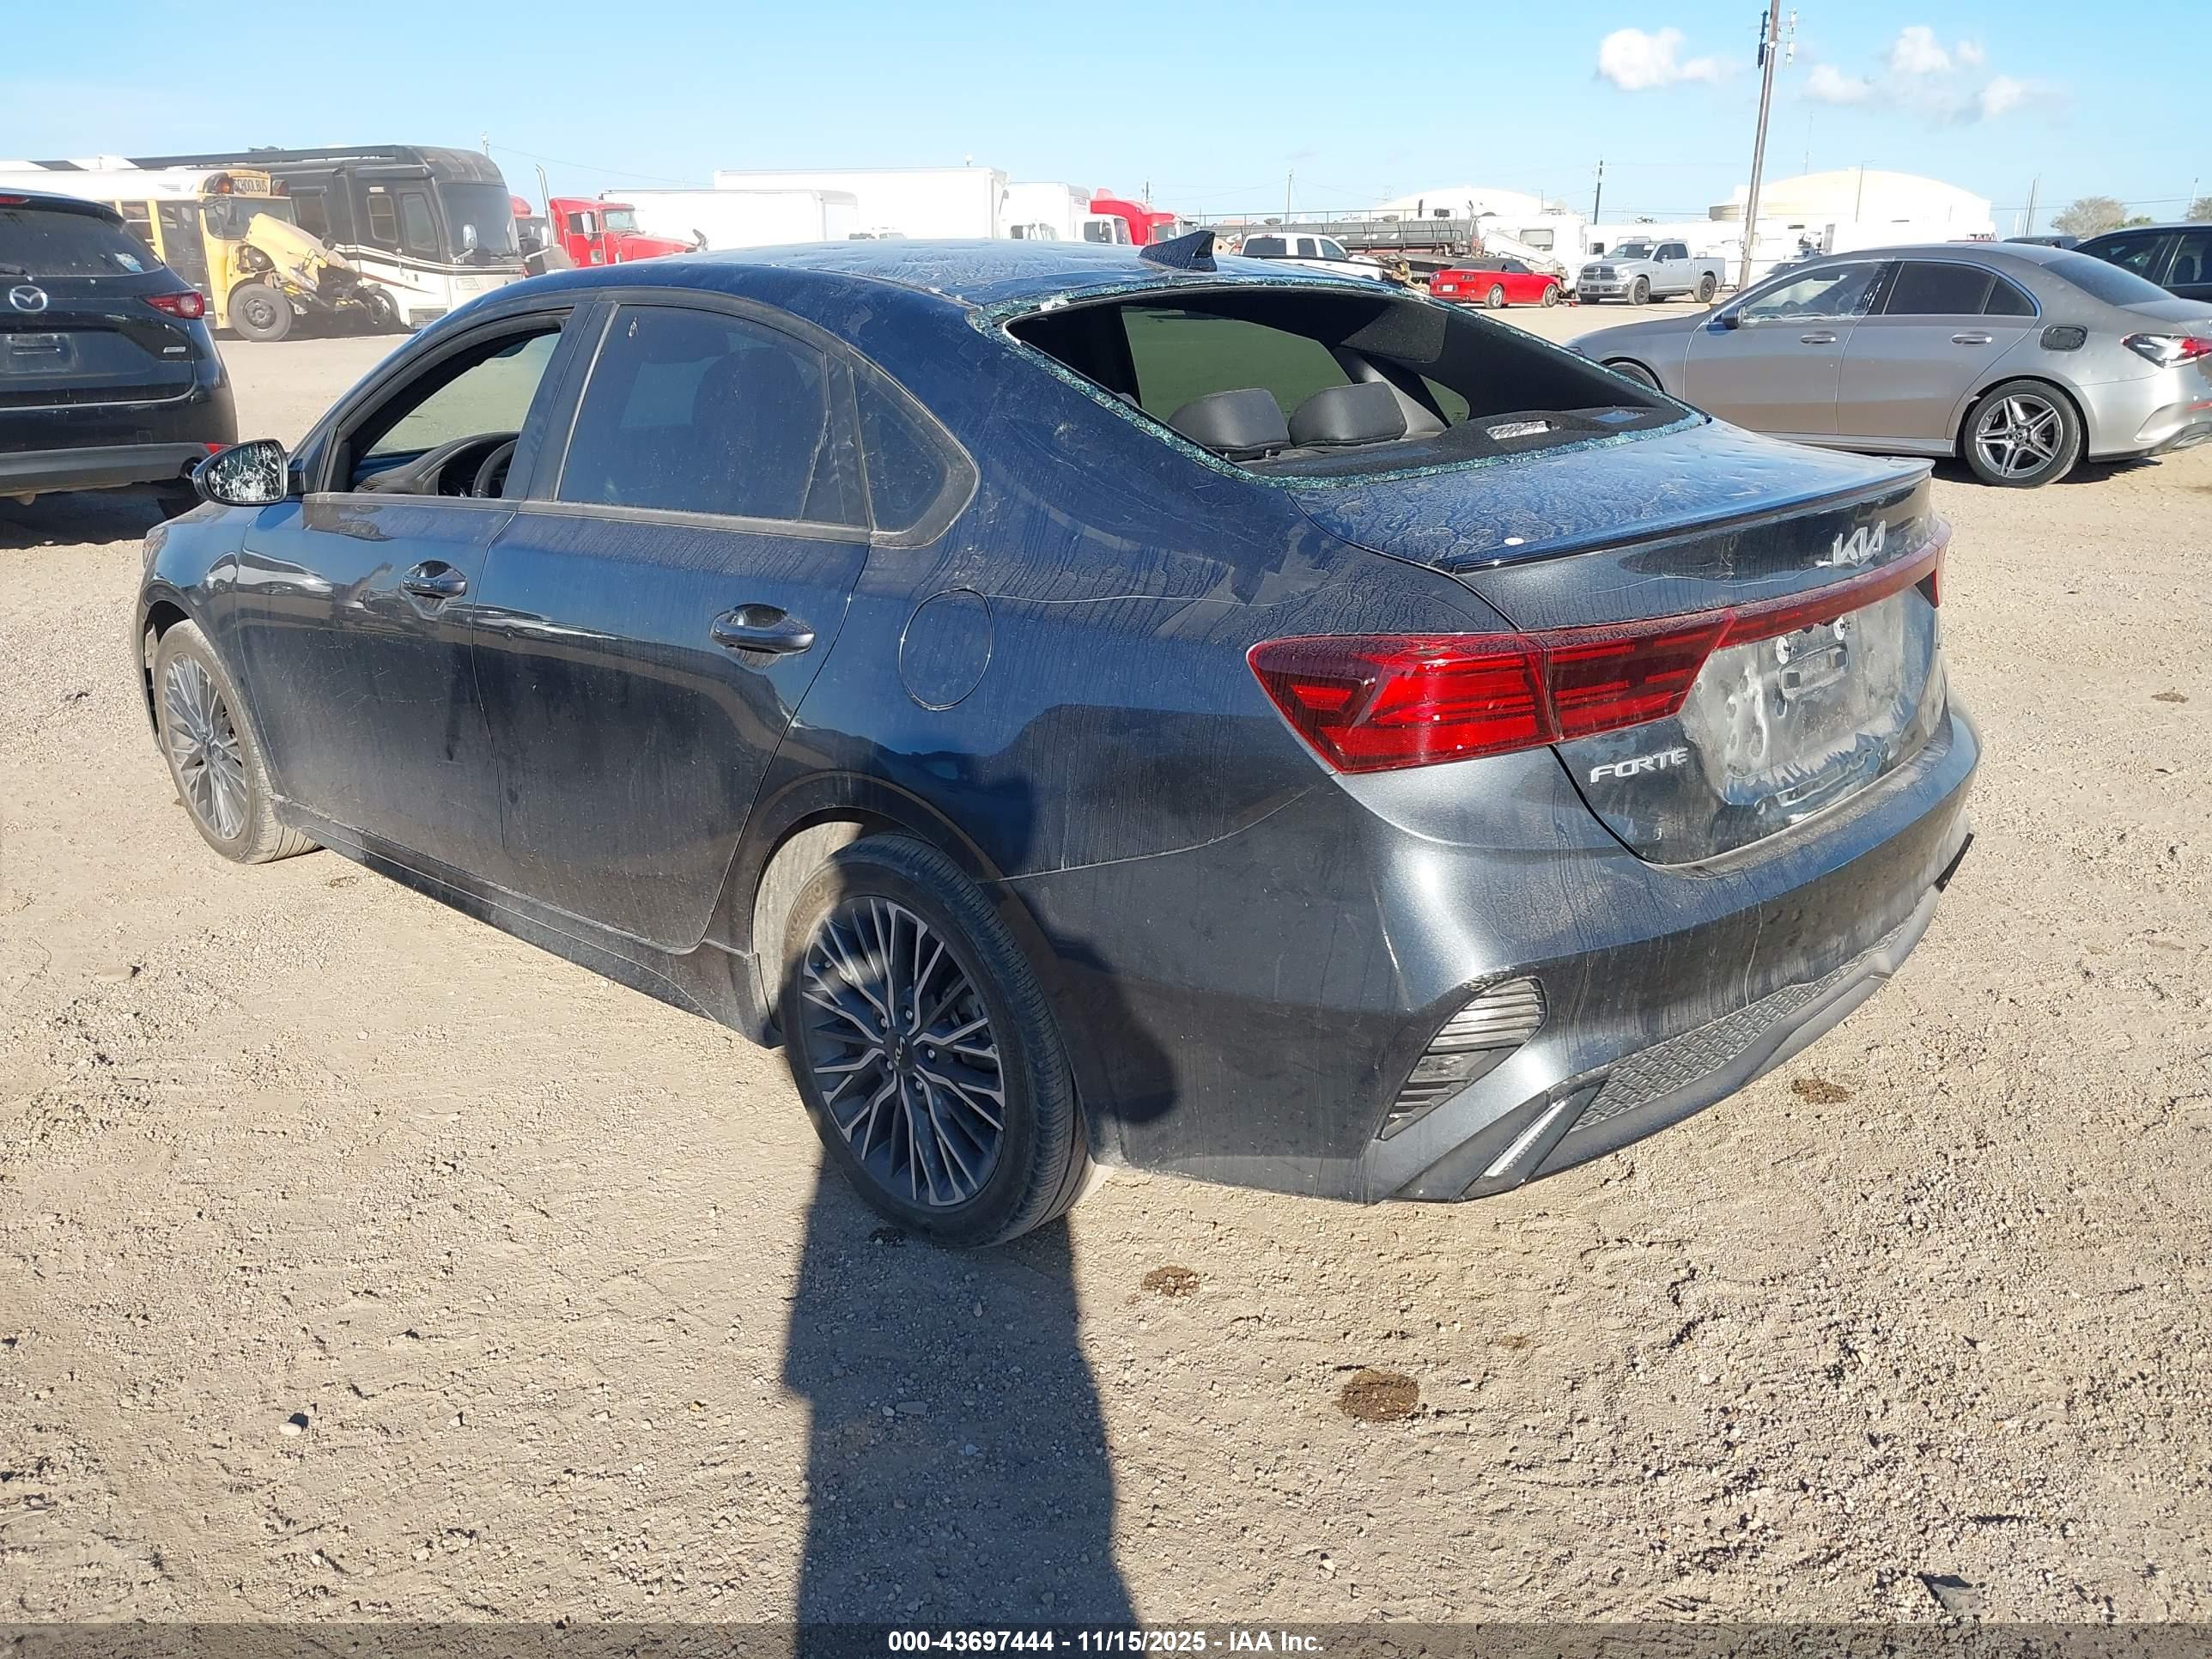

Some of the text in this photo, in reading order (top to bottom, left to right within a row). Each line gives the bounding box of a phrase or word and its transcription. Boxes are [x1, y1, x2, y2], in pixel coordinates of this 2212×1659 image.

[256, 179, 268, 193] BUS
[1832, 520, 1887, 566] KIA
[1590, 746, 1688, 783] FORTE
